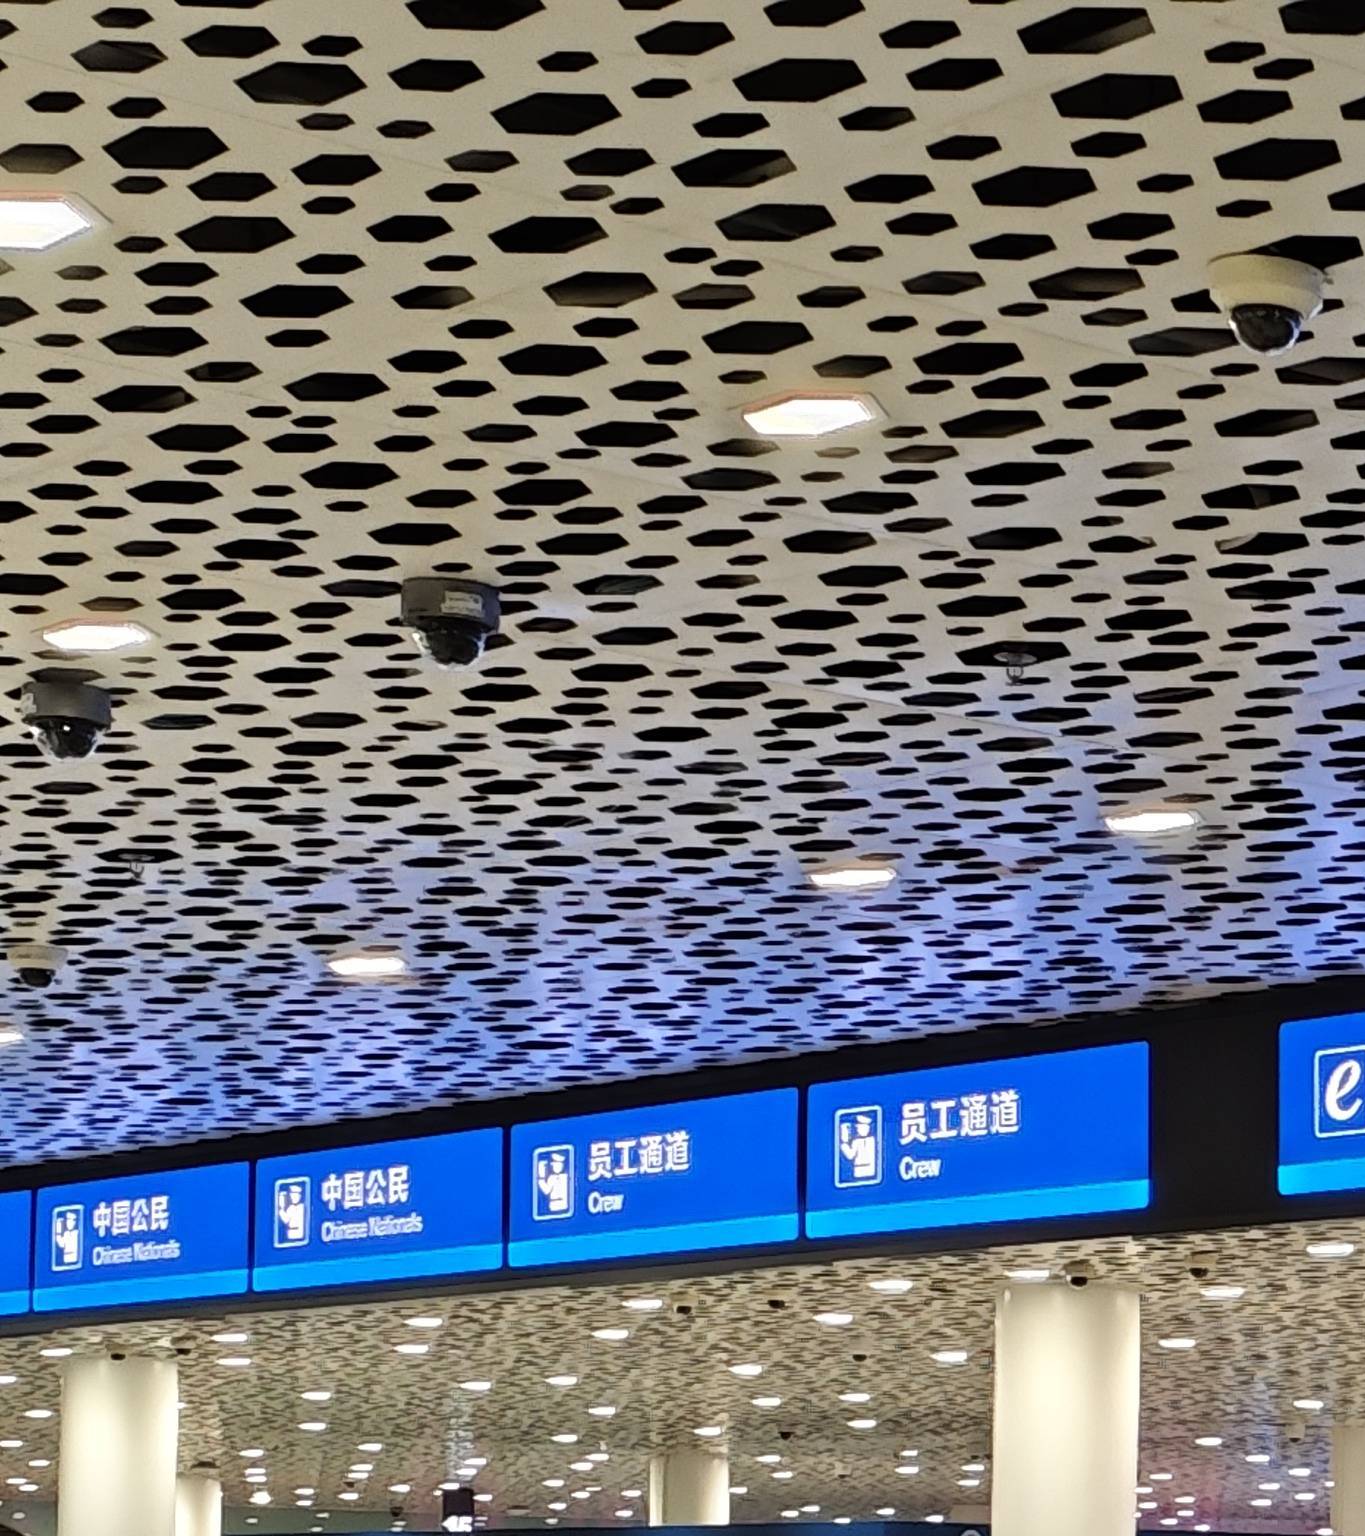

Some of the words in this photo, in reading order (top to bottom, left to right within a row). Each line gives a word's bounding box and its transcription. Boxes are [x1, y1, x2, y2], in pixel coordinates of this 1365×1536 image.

[899, 1090, 1021, 1144] 员工通道
[589, 1131, 690, 1184] 员工通道
[900, 1156, 941, 1181] Crew
[321, 1166, 409, 1209] 中国公民
[588, 1190, 624, 1215] Crew
[93, 1196, 169, 1238] 中国公民
